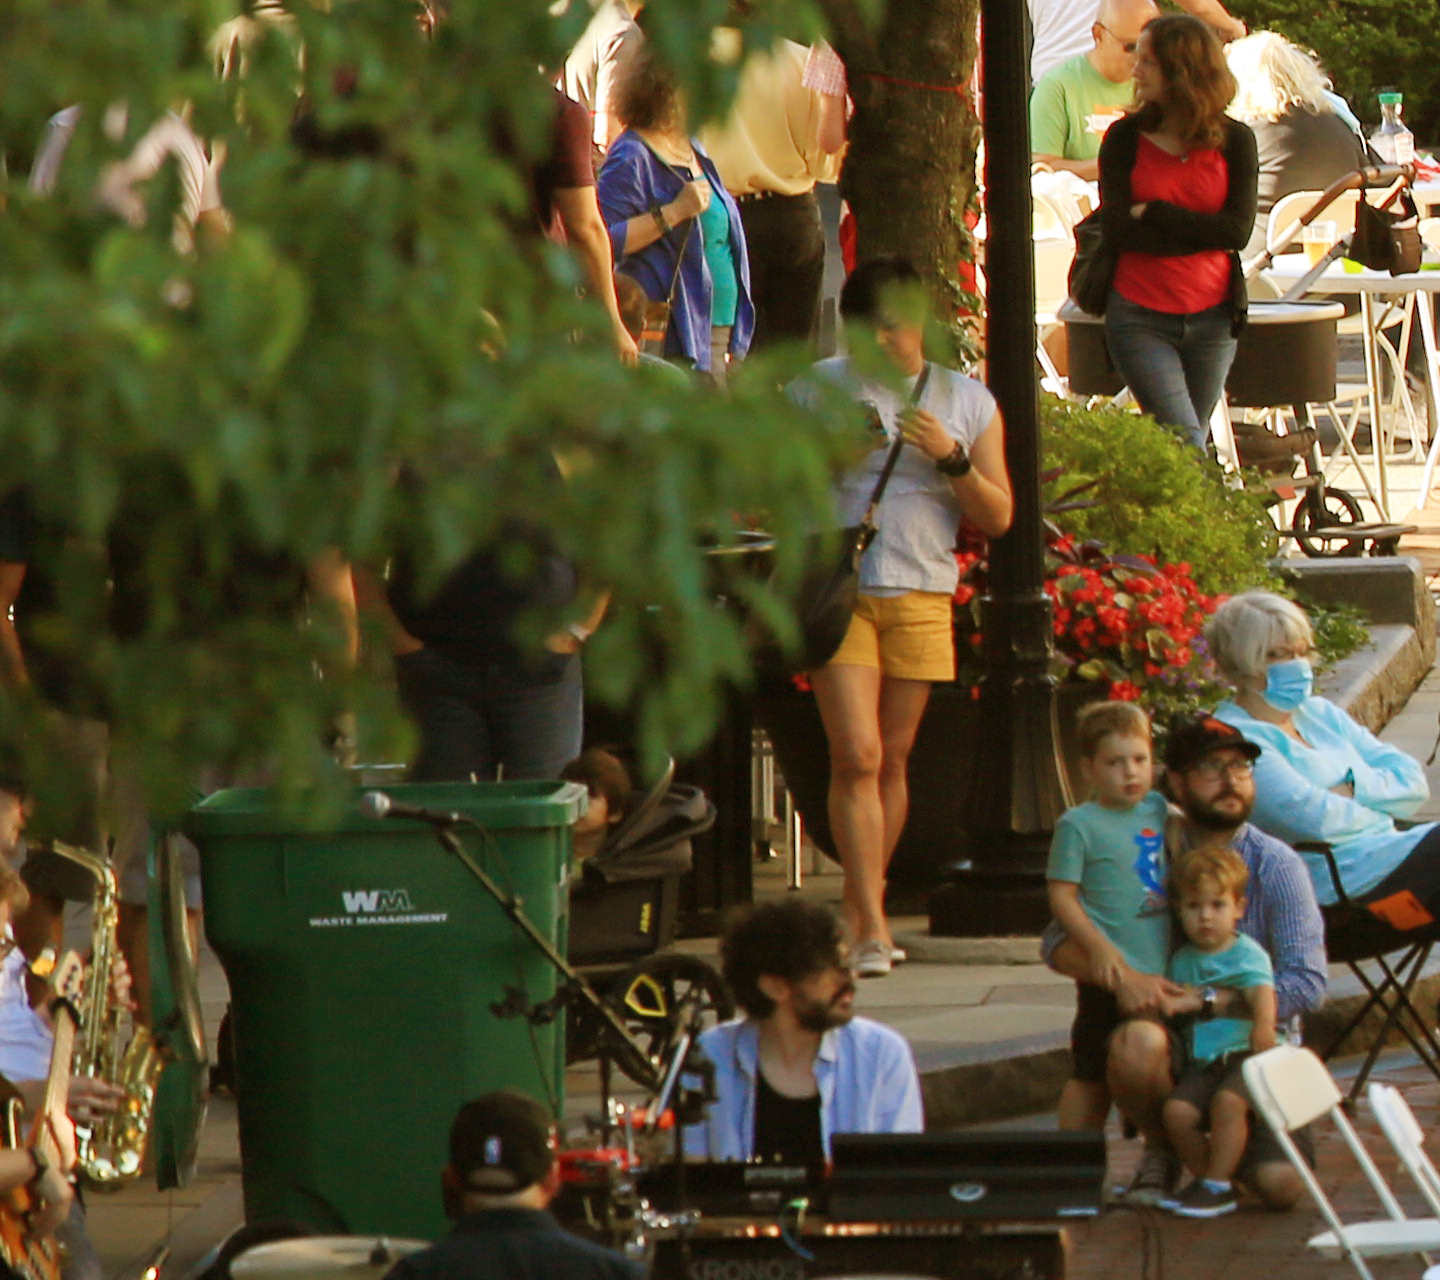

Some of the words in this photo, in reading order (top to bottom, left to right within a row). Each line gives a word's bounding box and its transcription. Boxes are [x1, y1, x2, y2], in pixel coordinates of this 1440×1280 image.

[342, 888, 412, 913] WM
[309, 917, 353, 927] WASTE
[356, 913, 448, 926] MANAGEMENT
